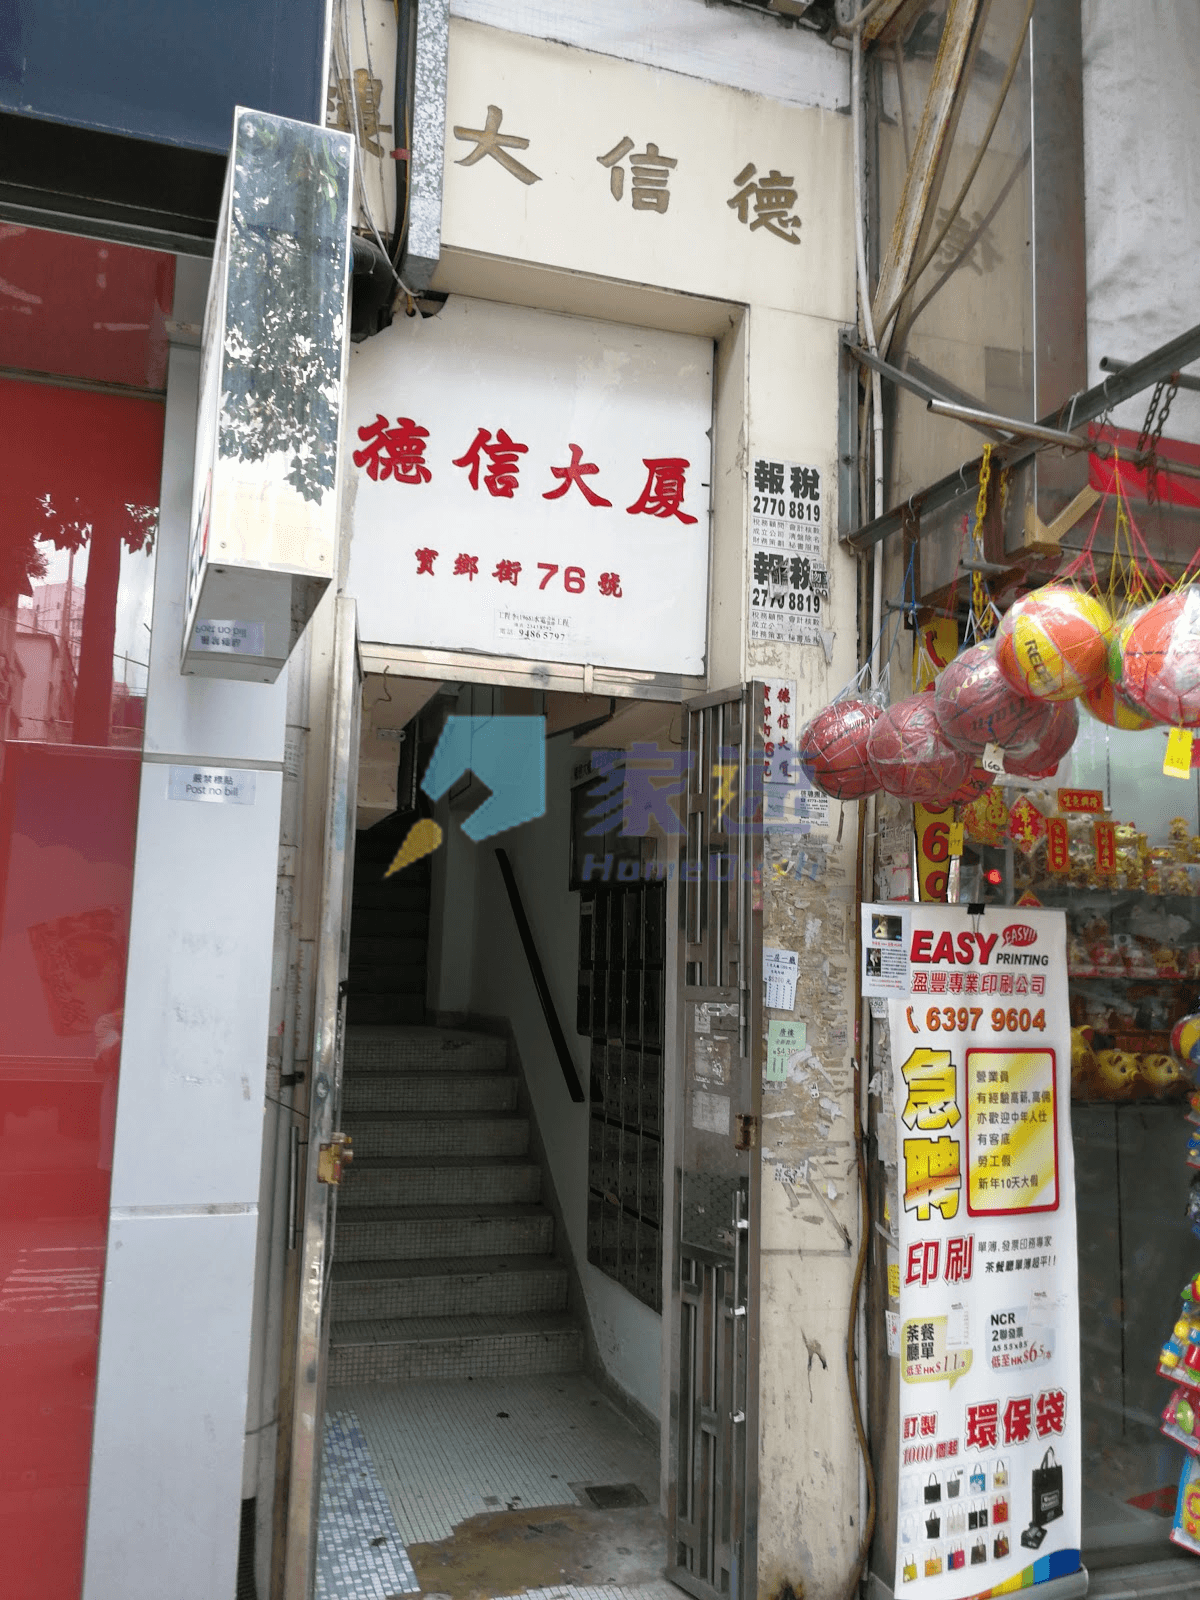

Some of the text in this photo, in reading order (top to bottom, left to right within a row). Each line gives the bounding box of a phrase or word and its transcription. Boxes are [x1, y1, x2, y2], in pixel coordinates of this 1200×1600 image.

[753, 496, 820, 522] 2770 8819
[788, 593, 820, 614] 8819
[185, 784, 206, 794] Post
[209, 786, 222, 795] no
[909, 929, 999, 965] EASY
[996, 953, 1049, 966] PRINTING
[912, 972, 1045, 995] 盈豐專業印刷公司
[926, 1006, 1047, 1032] 6397 9604
[976, 1110, 1047, 1125] 亦歡迎中年人仕
[977, 1133, 1011, 1146] 有客底
[977, 1155, 1011, 1168] 勞工假
[978, 1174, 1039, 1190] 新年10天大假
[904, 1234, 975, 1287] 印刷
[990, 1312, 1016, 1326] NCR
[903, 1414, 936, 1440] 訂製
[966, 1391, 1065, 1449] 環保袋
